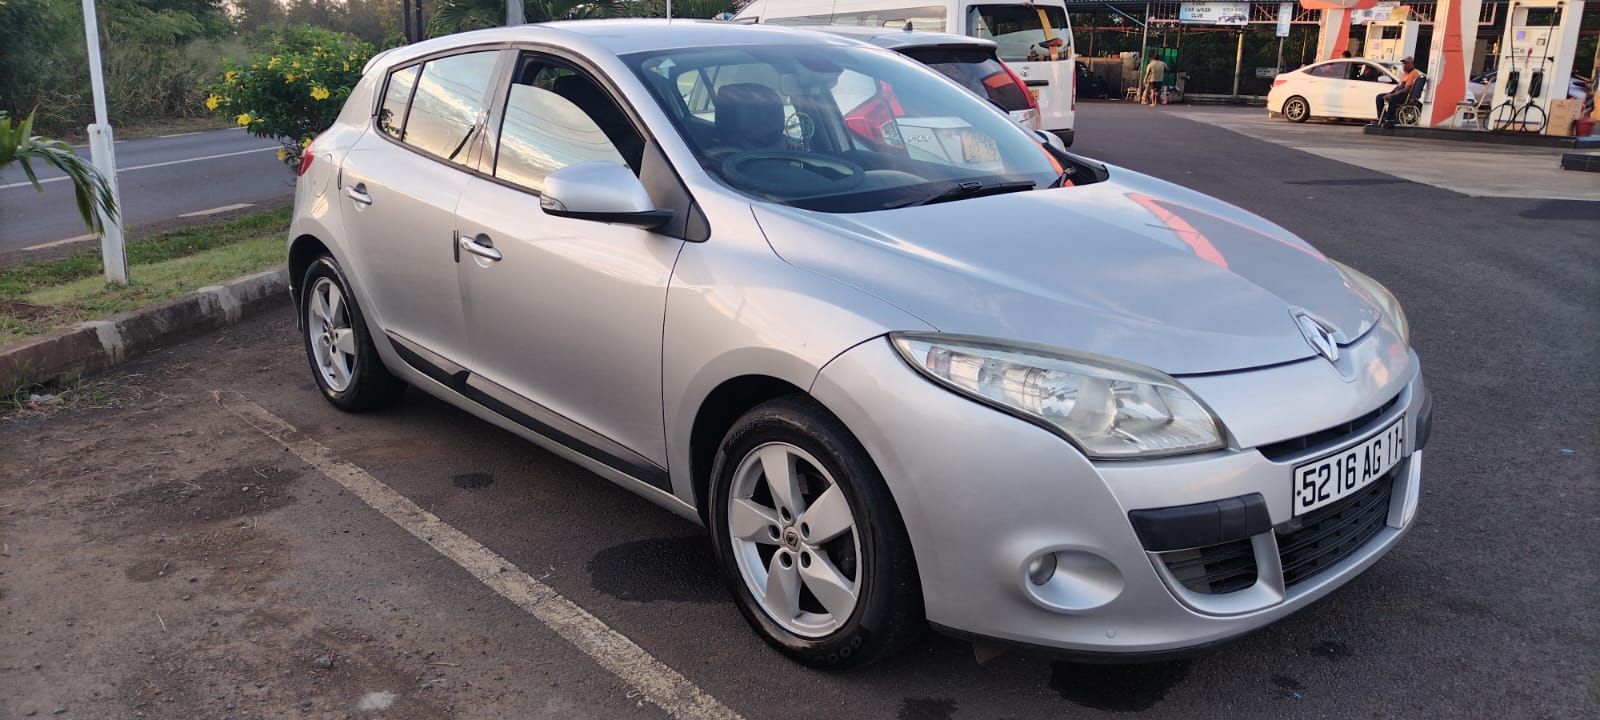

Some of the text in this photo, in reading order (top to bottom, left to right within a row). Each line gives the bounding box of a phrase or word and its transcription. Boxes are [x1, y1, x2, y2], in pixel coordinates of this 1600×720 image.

[1302, 427, 1399, 507] 5216 AG 11
